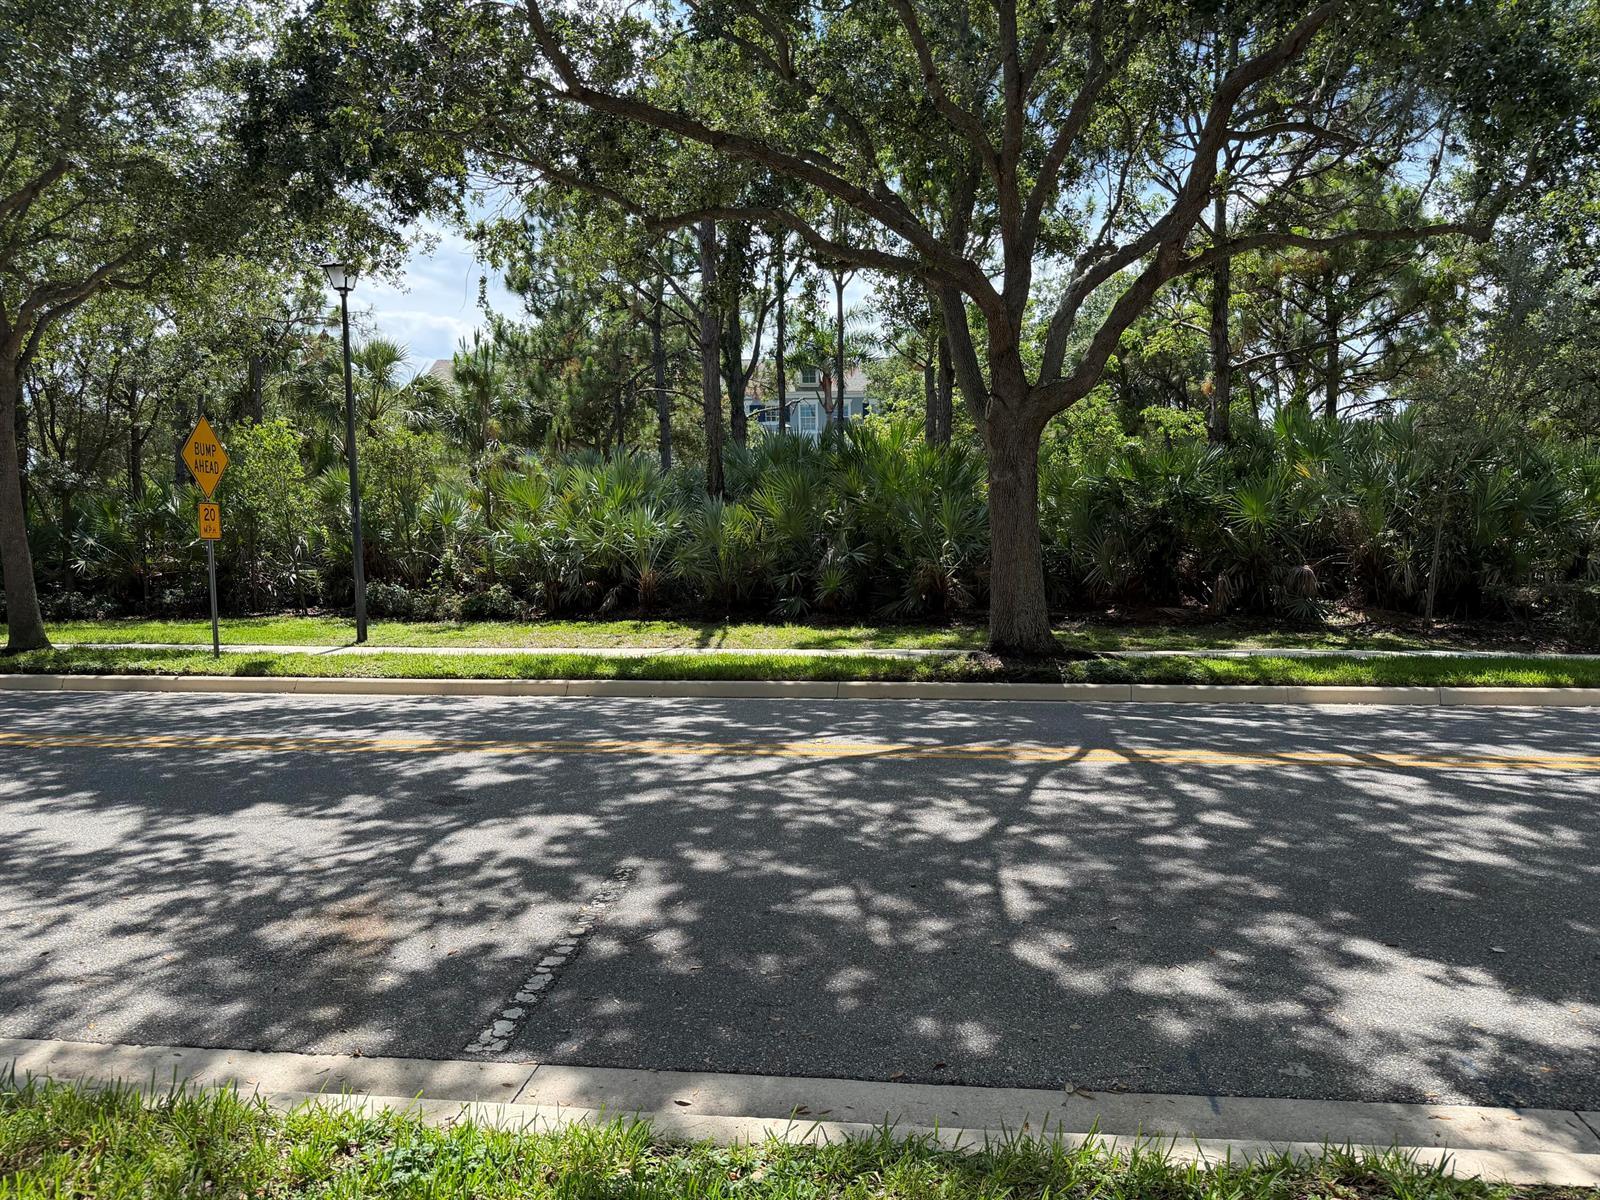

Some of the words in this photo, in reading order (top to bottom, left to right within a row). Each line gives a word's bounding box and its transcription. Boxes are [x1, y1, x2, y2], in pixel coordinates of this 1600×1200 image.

[194, 442, 217, 457] BUMP
[194, 459, 219, 475] AHEAD
[203, 507, 216, 522] 20
